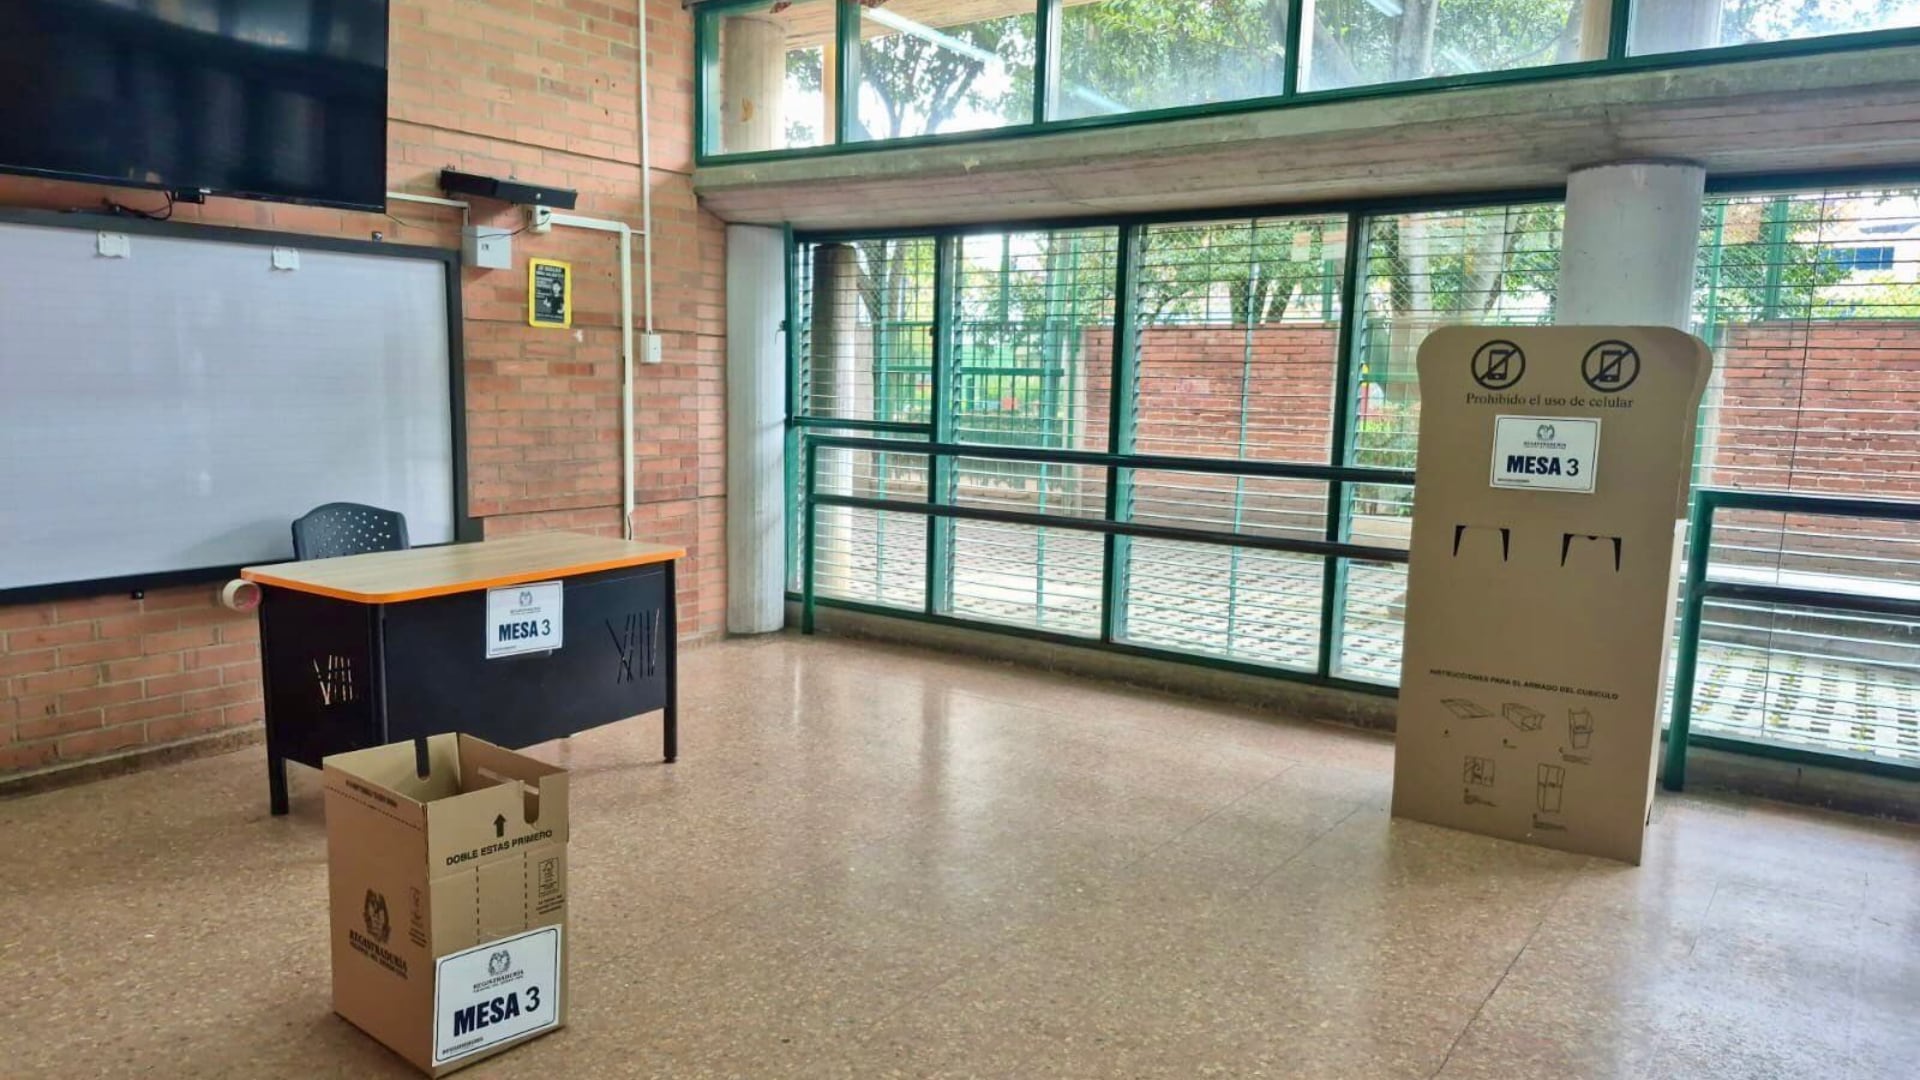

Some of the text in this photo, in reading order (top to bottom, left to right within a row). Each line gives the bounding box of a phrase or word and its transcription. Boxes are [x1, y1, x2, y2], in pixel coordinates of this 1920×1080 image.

[1466, 392, 1634, 409] Prohibido el uso de celular
[1507, 455, 1580, 477] MESA 3
[499, 619, 551, 642] MESA 3
[446, 830, 553, 866] DOBLE ESTAS PRIMERO
[454, 986, 541, 1037] MESA 3
